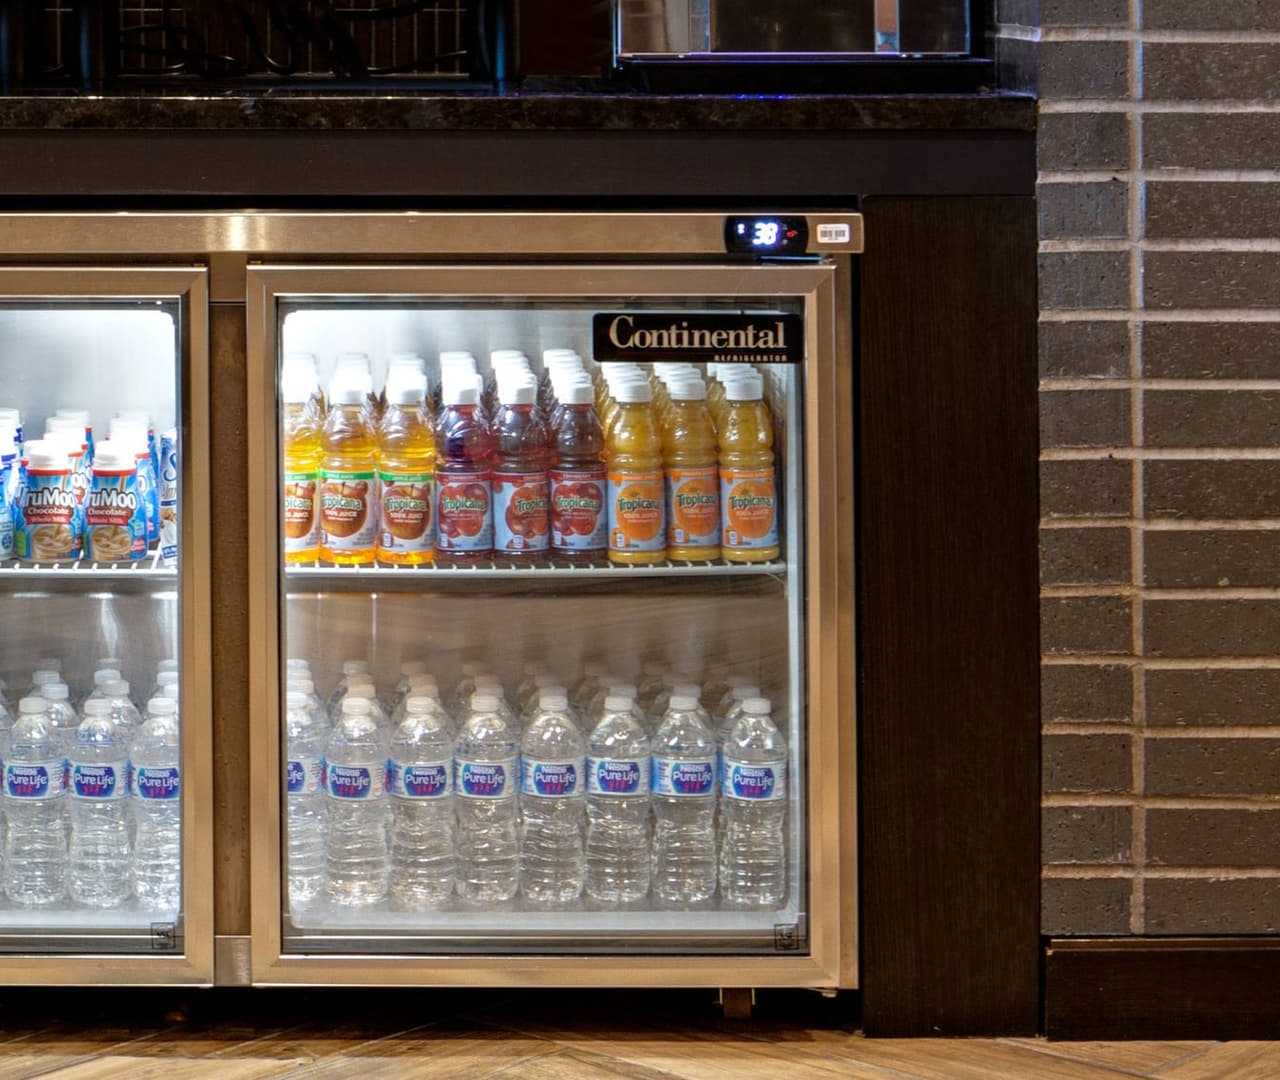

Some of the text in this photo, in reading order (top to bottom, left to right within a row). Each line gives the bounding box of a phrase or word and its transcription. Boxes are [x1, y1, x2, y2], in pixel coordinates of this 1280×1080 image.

[608, 315, 787, 349] Continental
[8, 774, 29, 784] Pure
[75, 773, 96, 784] Pure
[331, 775, 352, 786] Pure
[406, 774, 429, 784] Pure
[464, 772, 486, 783] Pure
[536, 772, 558, 783] Pure
[599, 770, 622, 780] Pure
[673, 770, 697, 781] Pure
[734, 775, 757, 786] Pure
[140, 776, 162, 786] Pure
